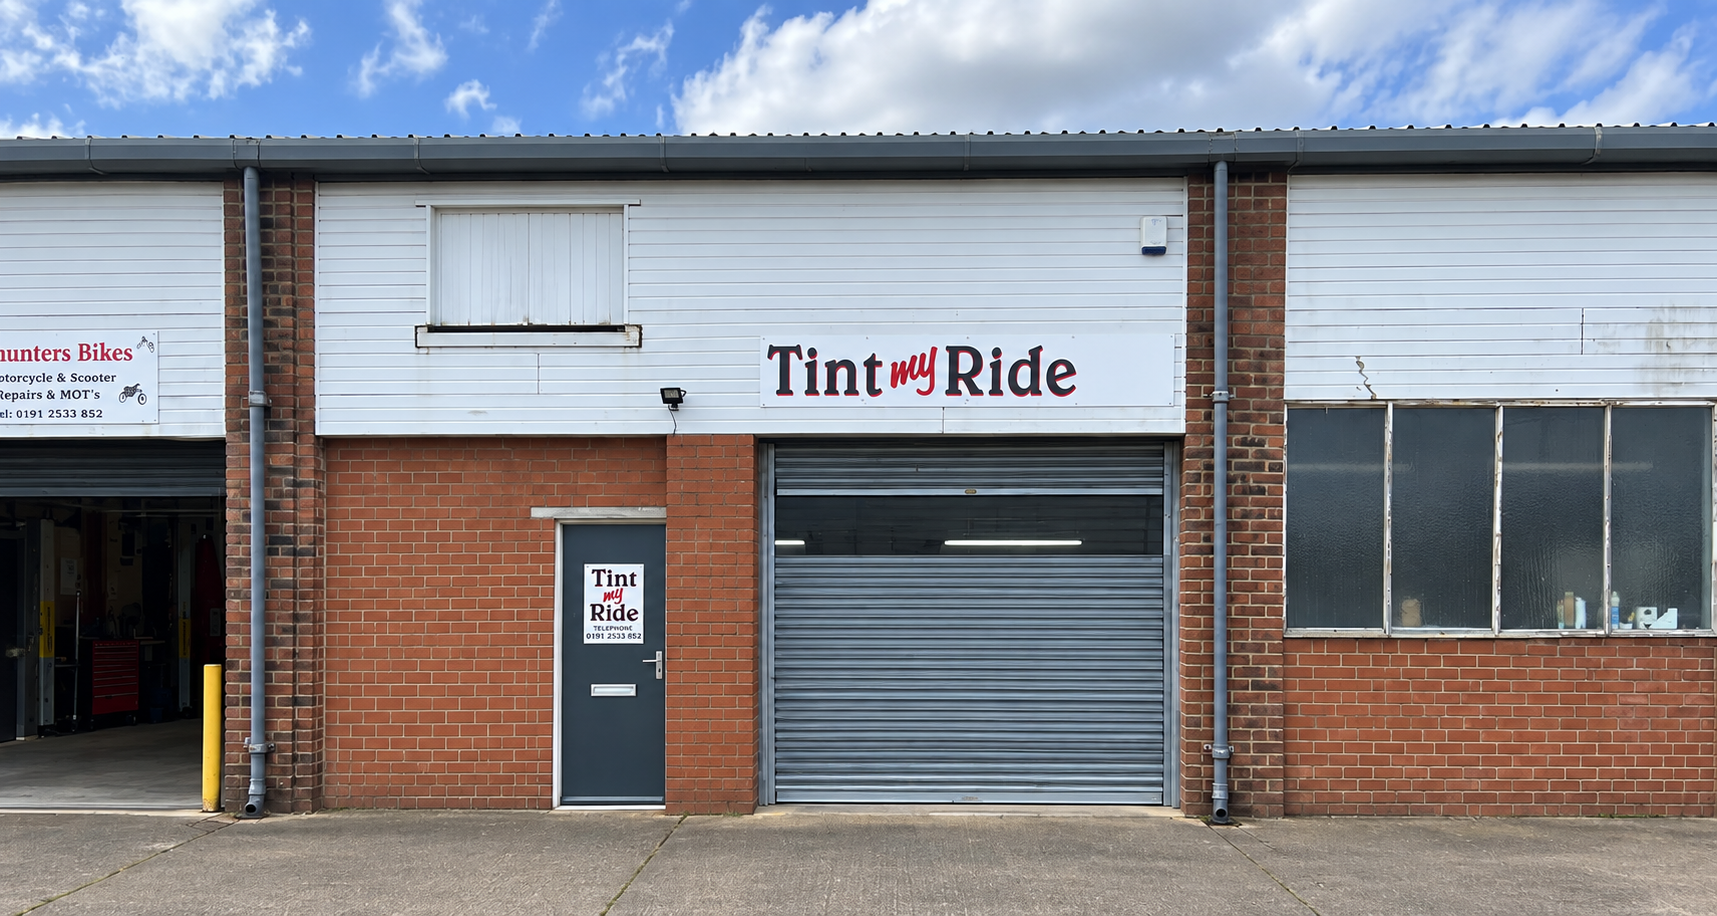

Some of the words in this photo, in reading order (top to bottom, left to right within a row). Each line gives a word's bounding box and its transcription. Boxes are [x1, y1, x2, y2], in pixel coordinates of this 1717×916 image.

[77, 342, 133, 362] Bikes
[56, 372, 67, 383] &
[70, 372, 117, 383] Scooter
[766, 343, 884, 398] Tint
[890, 346, 938, 397] my
[944, 344, 1077, 398] Ride
[46, 389, 56, 400] &
[60, 389, 101, 400] MOT's
[16, 409, 43, 419] 0191
[48, 409, 77, 419] 2533
[80, 409, 103, 419] 852
[591, 568, 637, 587] Tint
[603, 588, 623, 604] my
[589, 603, 639, 622] Ride
[586, 632, 605, 640] 0191
